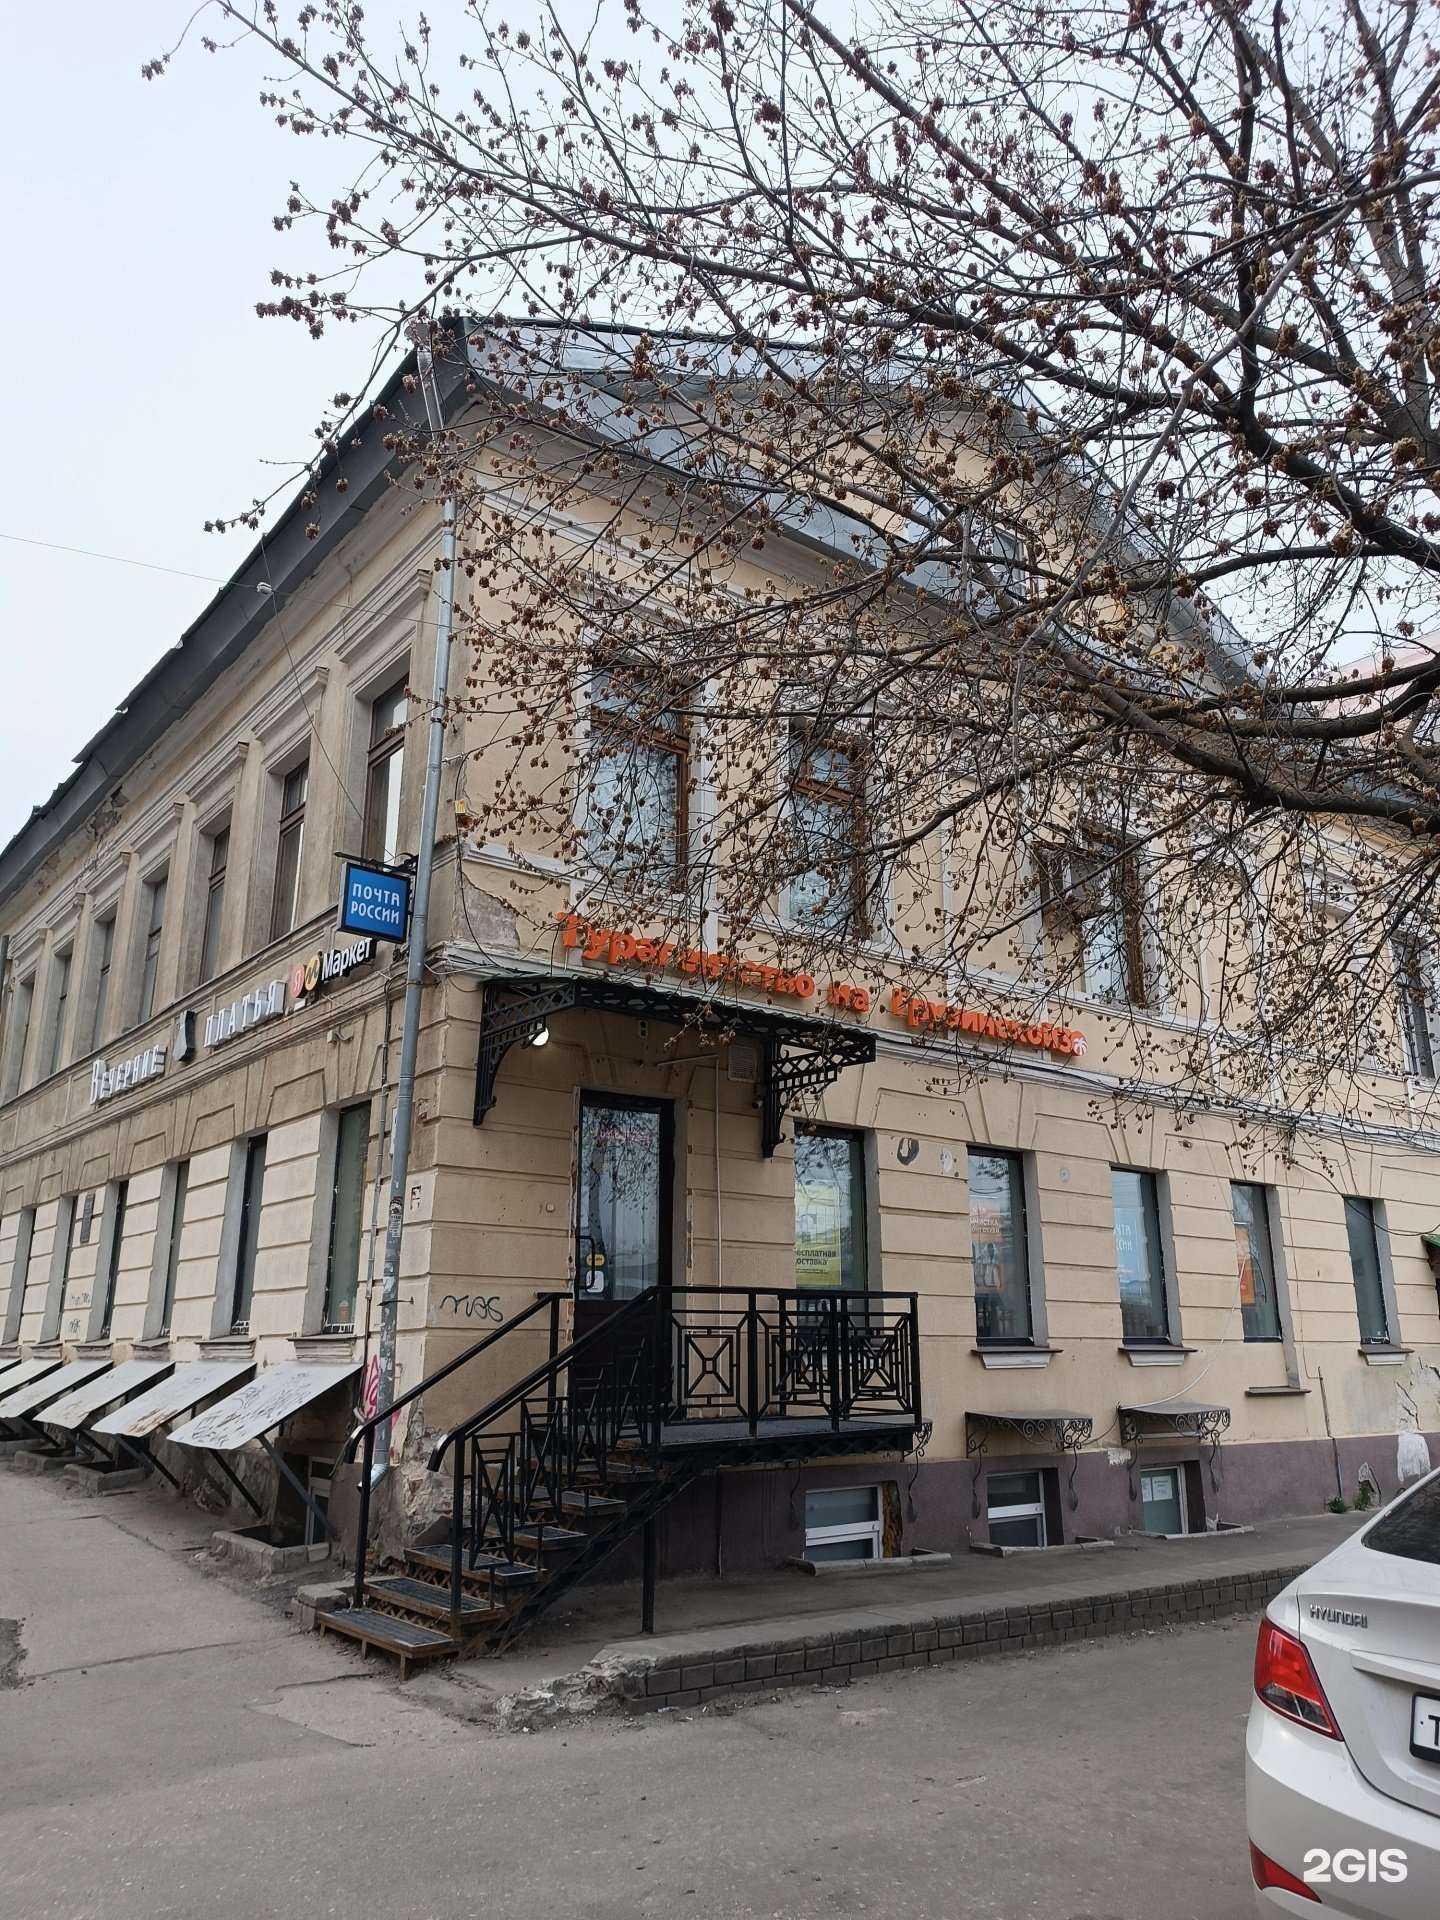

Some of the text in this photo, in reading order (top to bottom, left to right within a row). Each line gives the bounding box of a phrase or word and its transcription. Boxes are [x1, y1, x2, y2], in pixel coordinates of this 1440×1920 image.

[352, 882, 400, 907] ПОЧТА
[350, 900, 400, 925] РОССИИ
[321, 937, 373, 981] Маркет
[827, 983, 869, 1013] на
[1308, 1604, 1369, 1629] HYUNDAI
